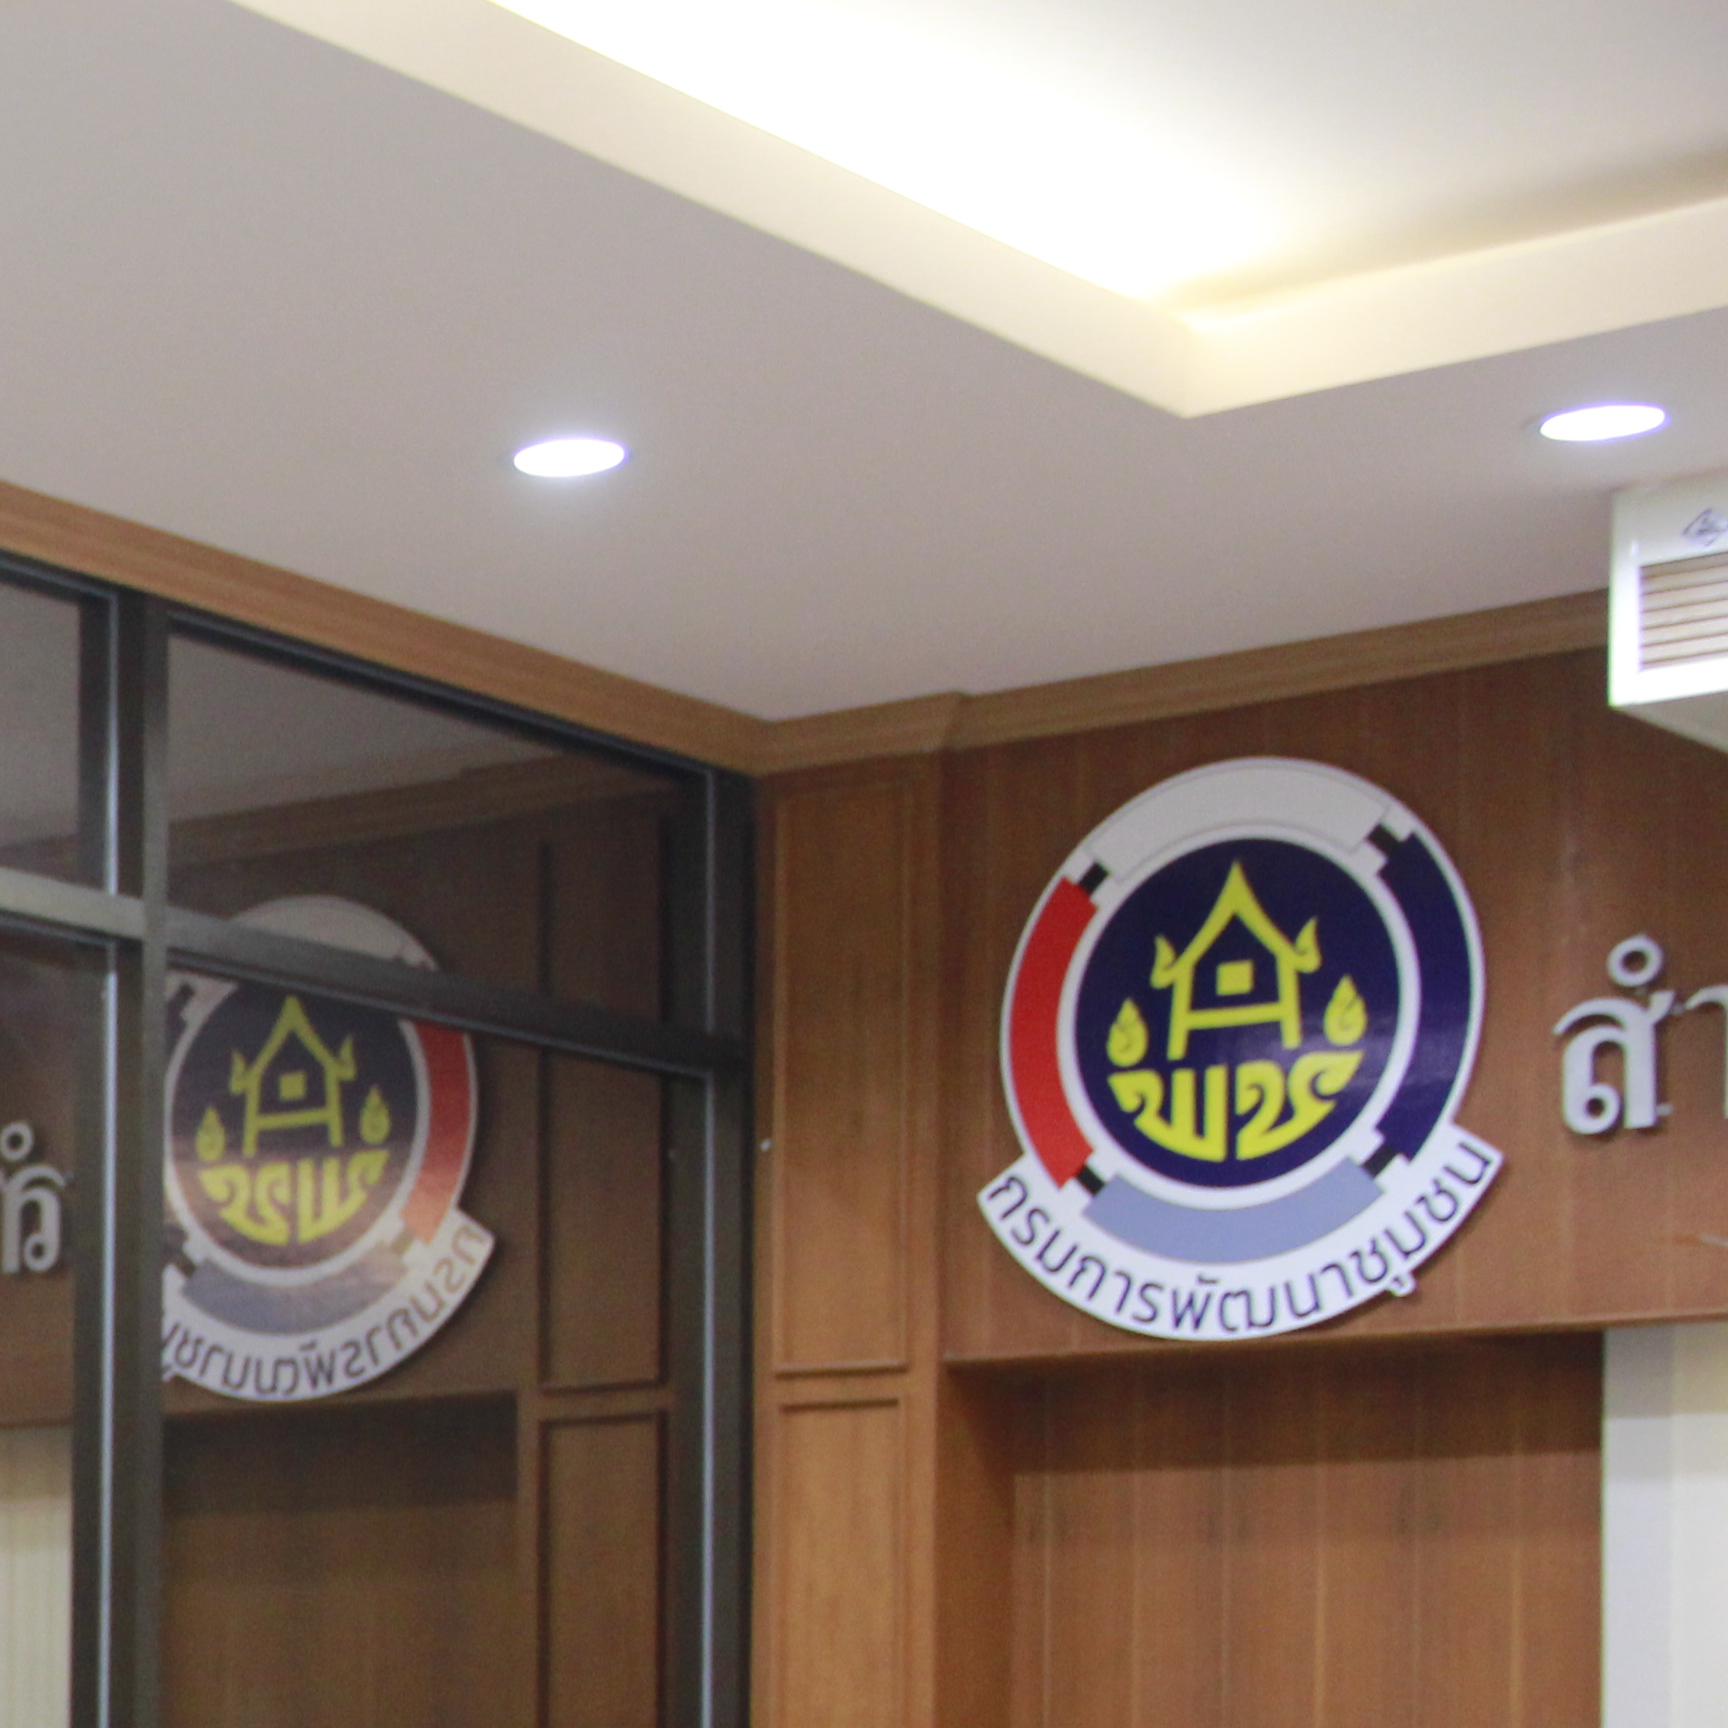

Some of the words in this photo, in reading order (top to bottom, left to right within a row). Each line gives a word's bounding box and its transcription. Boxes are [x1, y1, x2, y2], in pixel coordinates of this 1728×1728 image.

[987, 1140, 1495, 1335] กรมการพัฒนาชุมชน
